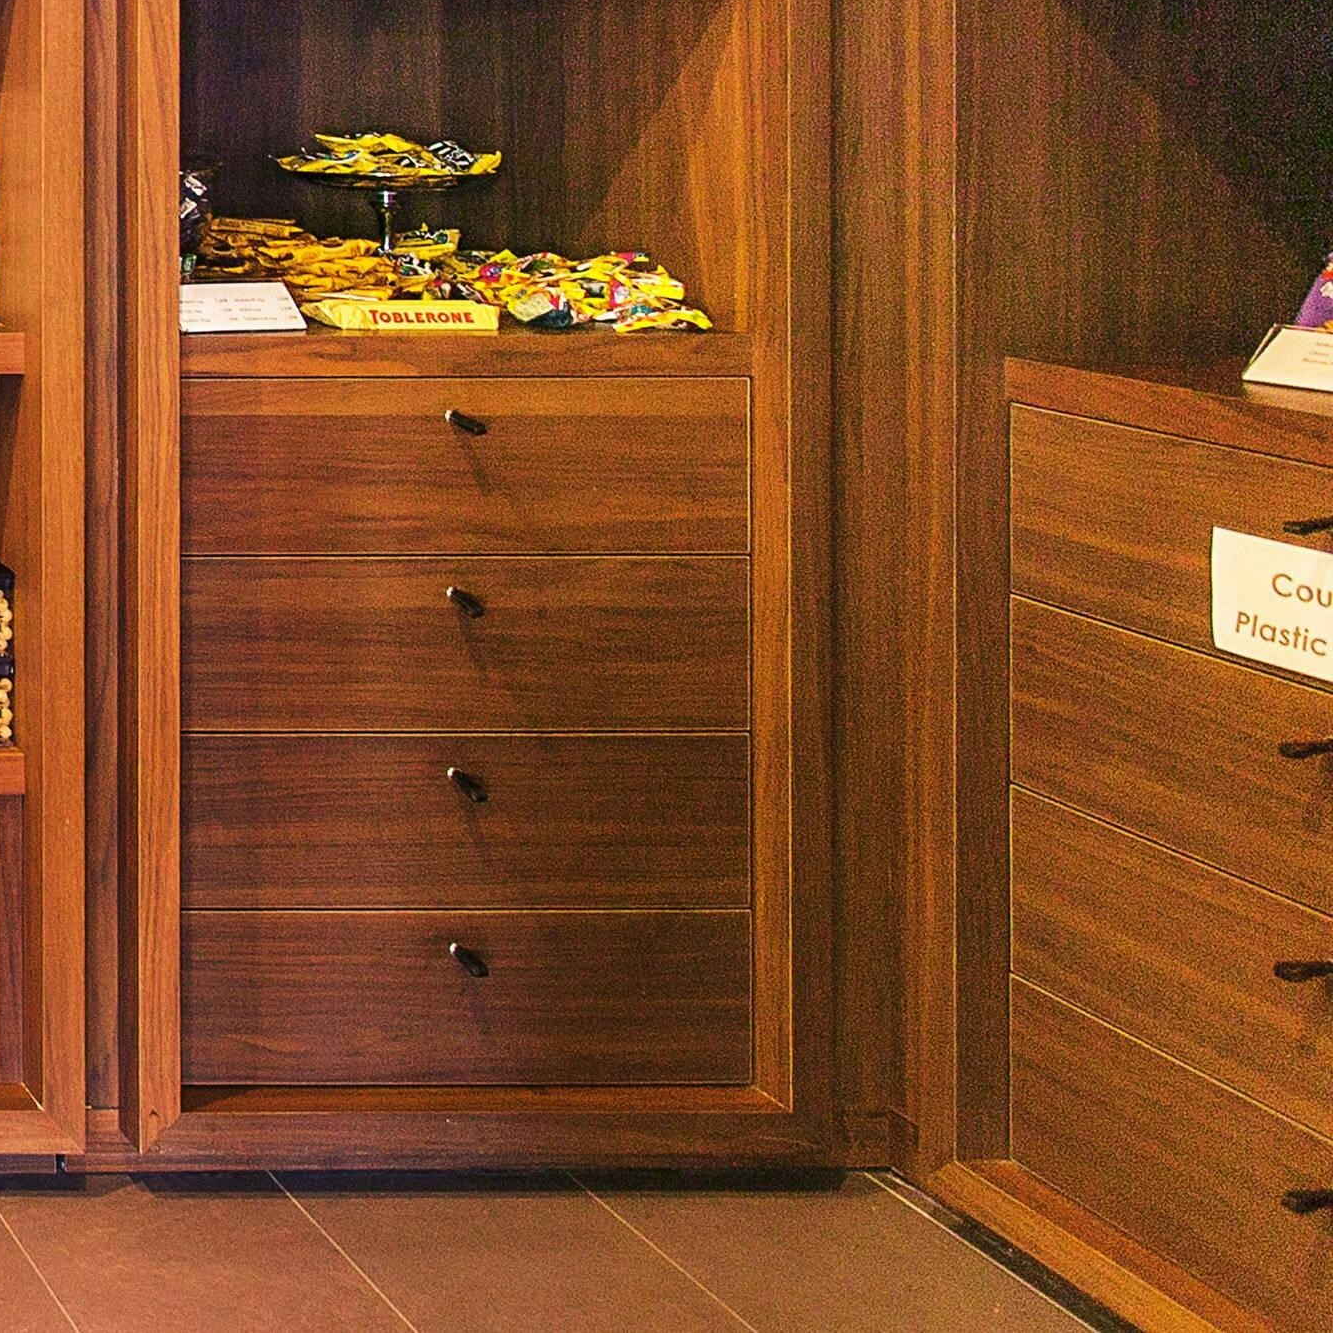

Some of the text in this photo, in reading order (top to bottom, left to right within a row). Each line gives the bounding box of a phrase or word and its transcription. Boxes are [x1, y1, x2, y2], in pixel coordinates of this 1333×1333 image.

[368, 309, 475, 325] TOBLERONE
[1271, 572, 1332, 609] Cou
[1235, 611, 1327, 656] Plastic
